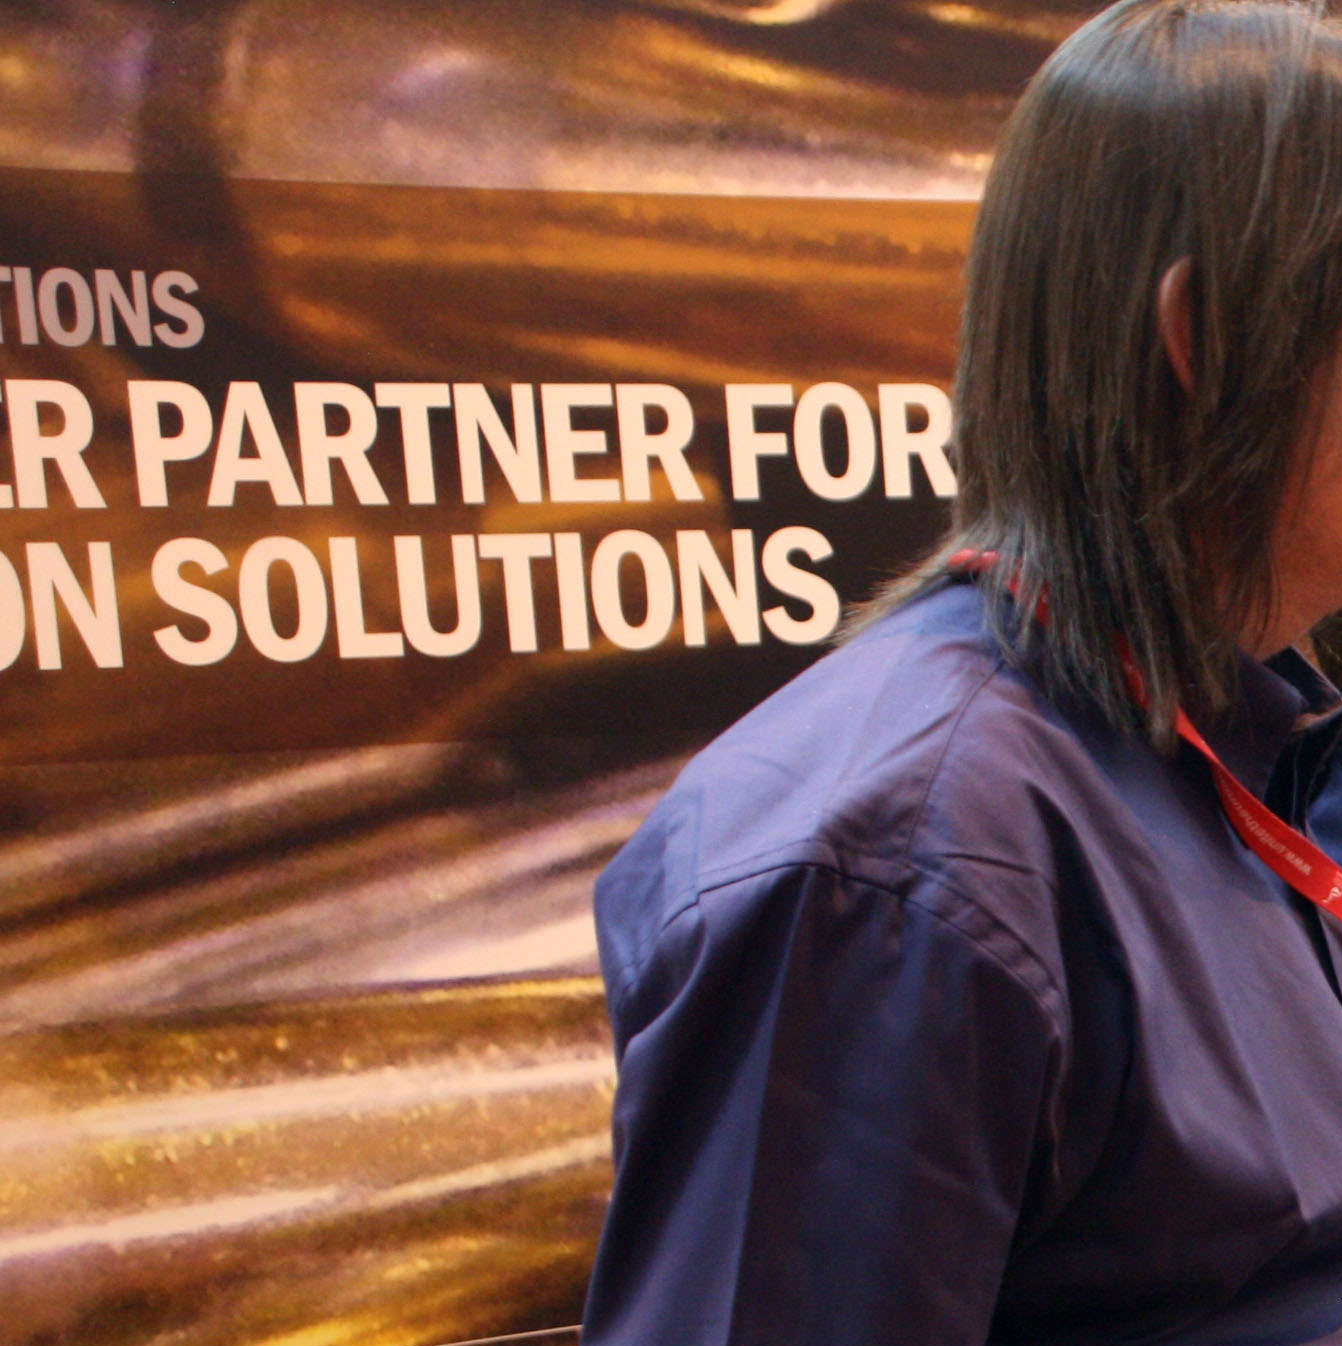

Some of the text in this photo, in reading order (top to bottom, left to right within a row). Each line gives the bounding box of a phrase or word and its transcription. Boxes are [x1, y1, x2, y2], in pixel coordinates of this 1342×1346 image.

[0, 379, 957, 509] R PARTNER FOR
[151, 526, 840, 667] SOLUTIONS
